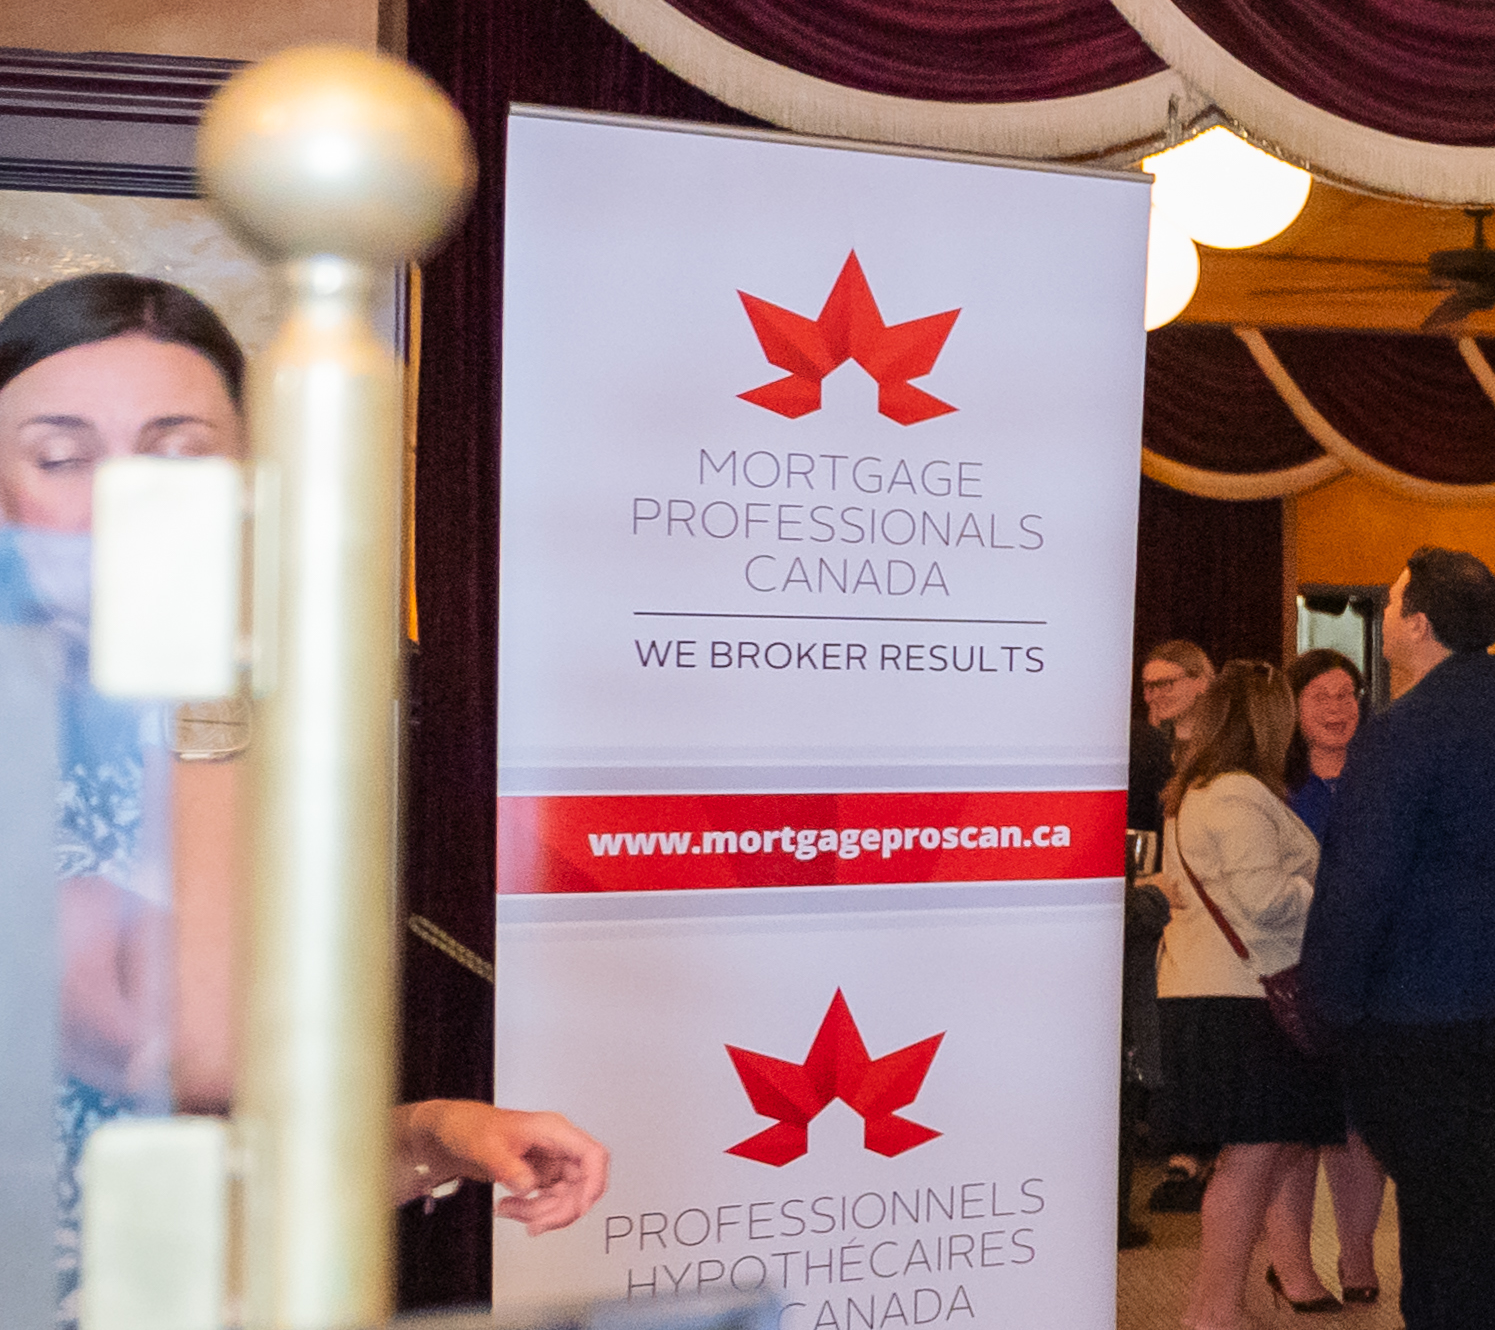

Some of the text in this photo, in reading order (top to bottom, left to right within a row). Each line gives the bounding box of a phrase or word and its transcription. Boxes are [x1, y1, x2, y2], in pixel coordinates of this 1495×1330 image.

[699, 448, 983, 499] MORTGAGE
[632, 497, 1045, 551] PROFESSIONALS
[744, 553, 951, 597] CANADA
[634, 638, 1046, 674] WE BROKER RESULTS
[588, 821, 1071, 862] www.mortgageproscan.ca
[603, 1177, 1046, 1256] PROFESSIONNELS
[626, 1227, 1036, 1302] HYPOTHÉCAIRES
